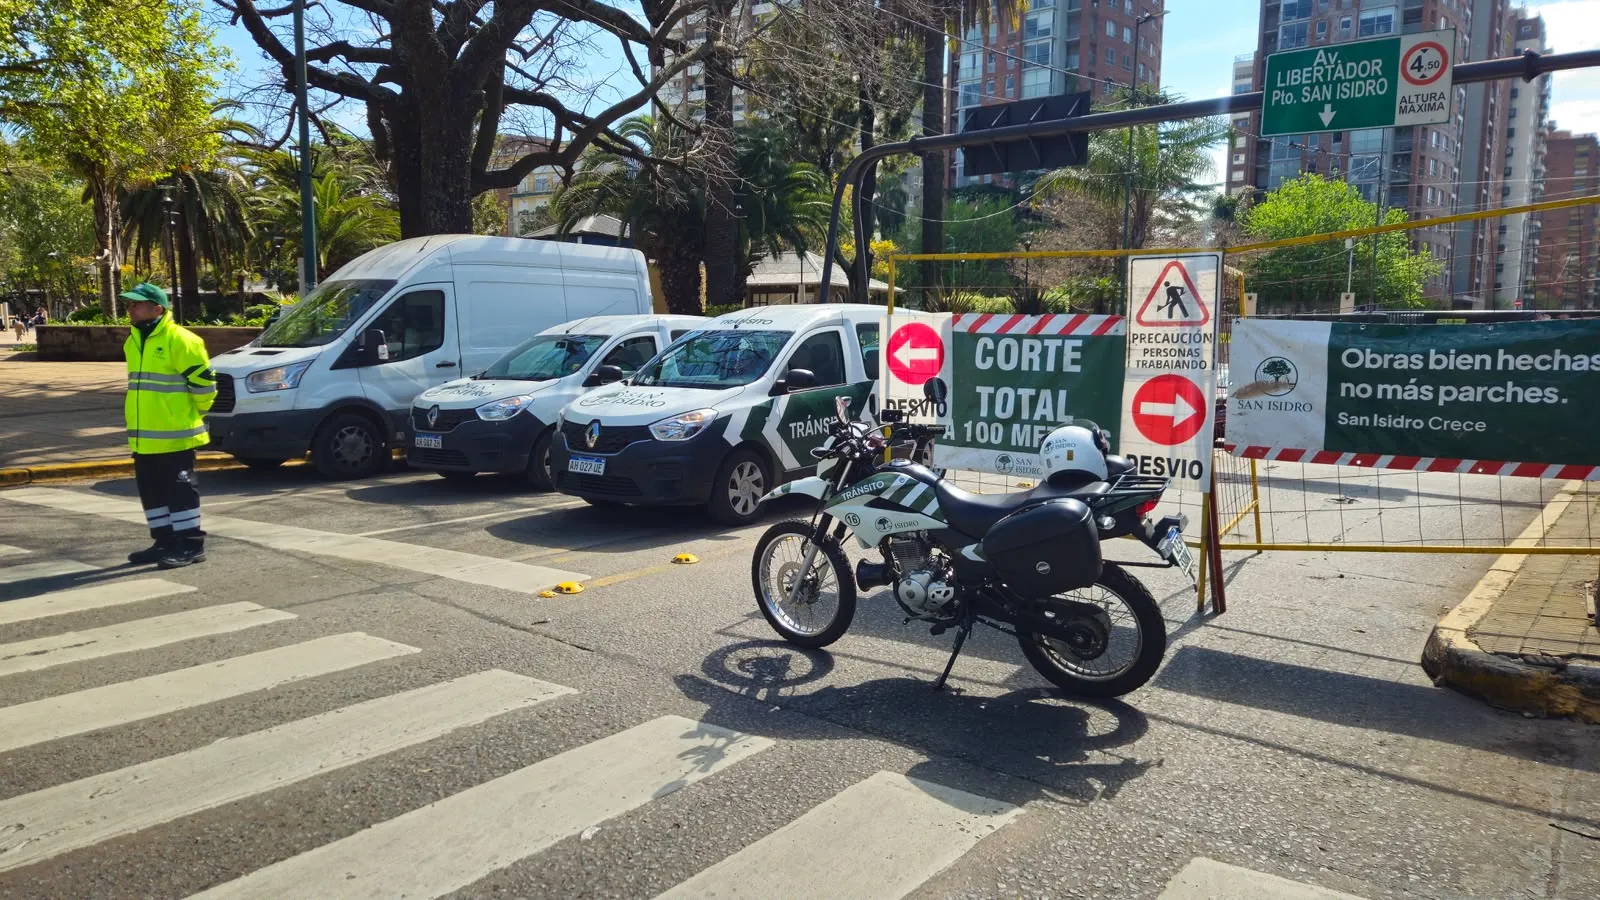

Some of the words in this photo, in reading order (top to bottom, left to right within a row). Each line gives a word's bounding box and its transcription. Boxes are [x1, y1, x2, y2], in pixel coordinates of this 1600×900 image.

[1313, 49, 1342, 67] Av.
[1277, 59, 1383, 87] LIBERTADOR
[1272, 90, 1297, 106] Pto.
[1302, 84, 1333, 103] SAN
[1336, 78, 1388, 99] ISIDRO
[1400, 91, 1446, 105] ALTURA
[1398, 102, 1445, 115] MAXIMA
[1132, 329, 1212, 344] PRECAUCIÓN
[975, 337, 1083, 373] CORTE
[1143, 347, 1200, 358] PERSONAS
[1341, 348, 1424, 370] Obras
[1428, 349, 1492, 371] bien
[1496, 349, 1600, 372] hechas
[1340, 381, 1373, 399] no
[1376, 378, 1434, 401] más
[1437, 381, 1569, 407] parches.
[886, 398, 947, 418] DESVIO
[975, 385, 1074, 424] TOTAL
[1237, 400, 1263, 410] SAN
[1268, 401, 1313, 412] ISIDRO
[1337, 412, 1370, 426] San
[1373, 413, 1424, 430] Isidro
[1428, 416, 1487, 432] Crece
[963, 420, 1004, 445] 100
[570, 460, 579, 470] AH
[1015, 458, 1033, 466] SAN
[842, 481, 885, 501] TRÁNSITO
[847, 515, 858, 525] 16
[894, 520, 919, 529] ISIDRO
